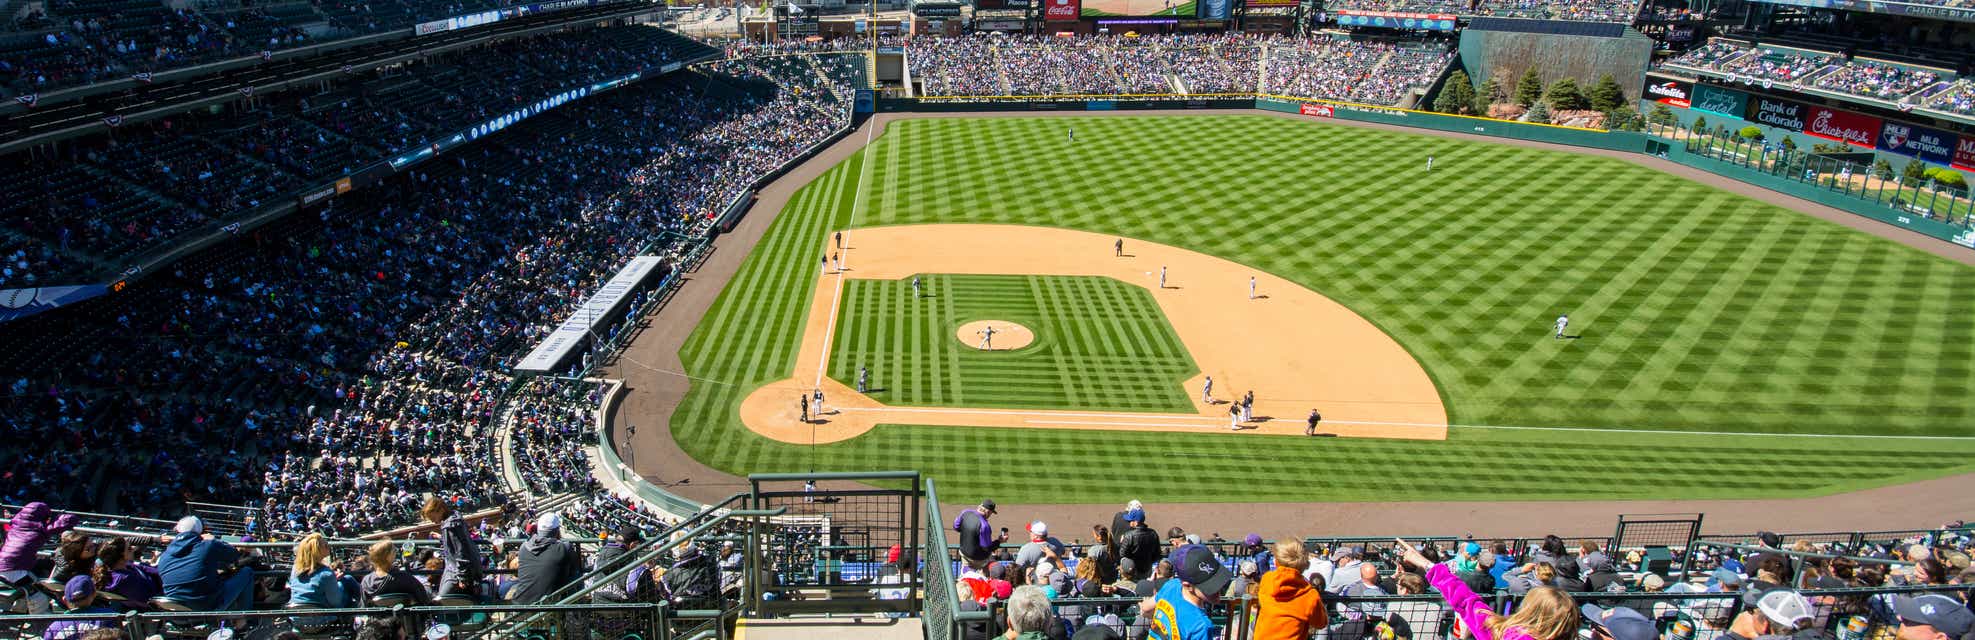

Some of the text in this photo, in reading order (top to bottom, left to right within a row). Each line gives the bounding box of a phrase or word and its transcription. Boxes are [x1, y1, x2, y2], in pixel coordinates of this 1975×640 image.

[1649, 85, 1686, 99] Safelite
[1699, 98, 1737, 113] dental
[1760, 99, 1799, 117] Bank of
[1758, 111, 1803, 129] Colorado
[1886, 124, 1909, 136] MLB
[1920, 134, 1940, 145] MLB
[1906, 140, 1949, 156] NETWORK
